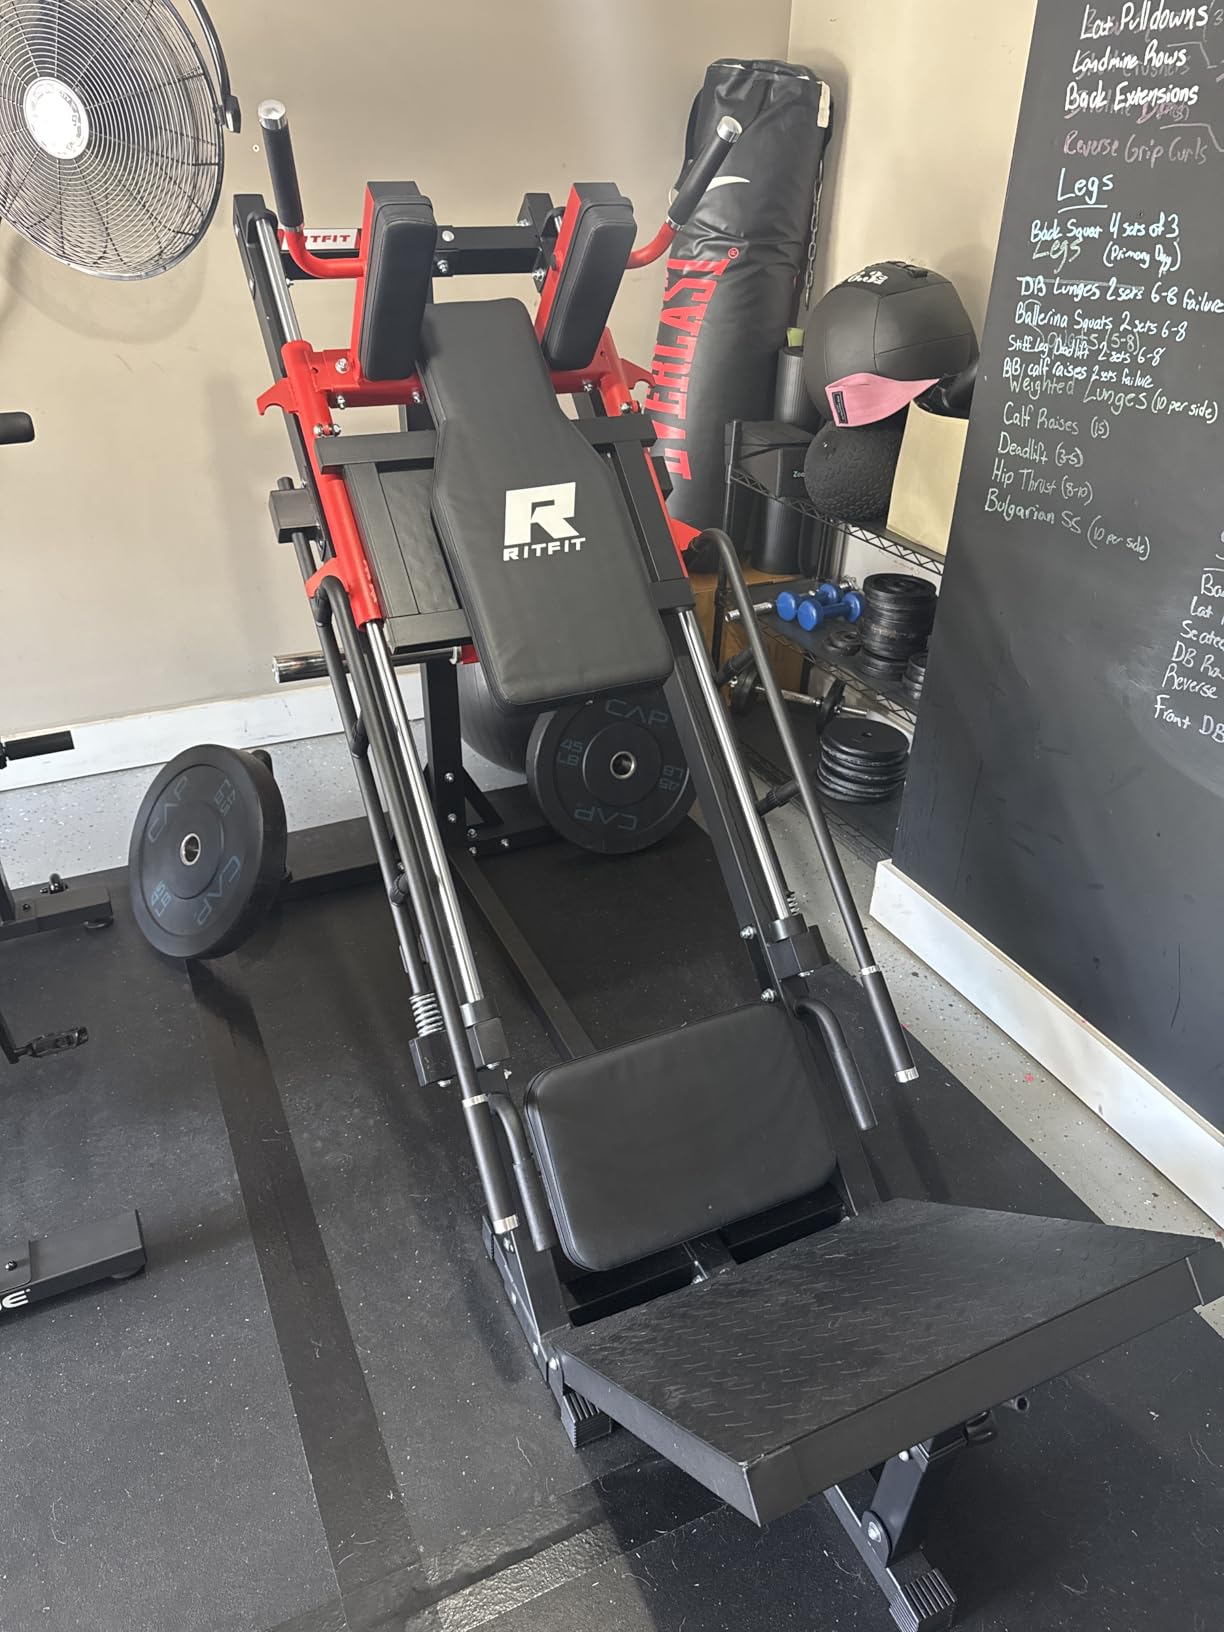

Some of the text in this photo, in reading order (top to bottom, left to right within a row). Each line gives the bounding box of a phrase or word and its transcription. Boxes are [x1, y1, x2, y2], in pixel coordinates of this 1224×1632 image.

[1080, 4, 1113, 40] Lat
[1072, 46, 1139, 74] Landmine
[1144, 39, 1187, 67] Rows
[1065, 80, 1107, 111] Back
[1114, 81, 1199, 111] Extensions
[1063, 130, 1208, 168] Reverse Grip Curls
[1057, 168, 1114, 204] Legs
[1031, 219, 1062, 242] Back
[1110, 212, 1121, 239] 4
[1149, 212, 1165, 237] of
[1166, 213, 1180, 239] 3
[1020, 277, 1046, 297] DB
[1053, 278, 1100, 302] Lunges
[1151, 282, 1178, 305] 6-8
[1015, 301, 1188, 341] Ballerina Squats 2 sets 6-8
[1003, 357, 1021, 378] BB
[1052, 362, 1087, 379] raises
[1122, 368, 1154, 389] failure
[1137, 347, 1166, 366] 6-8
[1083, 376, 1147, 415] Lunges
[1168, 399, 1187, 415] per
[1189, 401, 1219, 424] side)
[1003, 401, 1033, 425] Calf
[1037, 408, 1079, 435] Raises
[998, 432, 1048, 464] Deadlift
[992, 458, 1093, 506] Hip Thrust (8-10)
[984, 488, 1054, 524] Bulgarian
[1106, 532, 1123, 544] per
[1126, 536, 1150, 561] side)
[503, 537, 586, 561] RITFIT
[1190, 596, 1213, 618] Lat
[1172, 641, 1196, 668] DB
[1162, 662, 1218, 699] Reverse
[605, 699, 669, 725] CAP
[1154, 694, 1191, 729] Front
[147, 775, 188, 843] CAP
[574, 806, 638, 831] CAP
[196, 856, 240, 925] CAP
